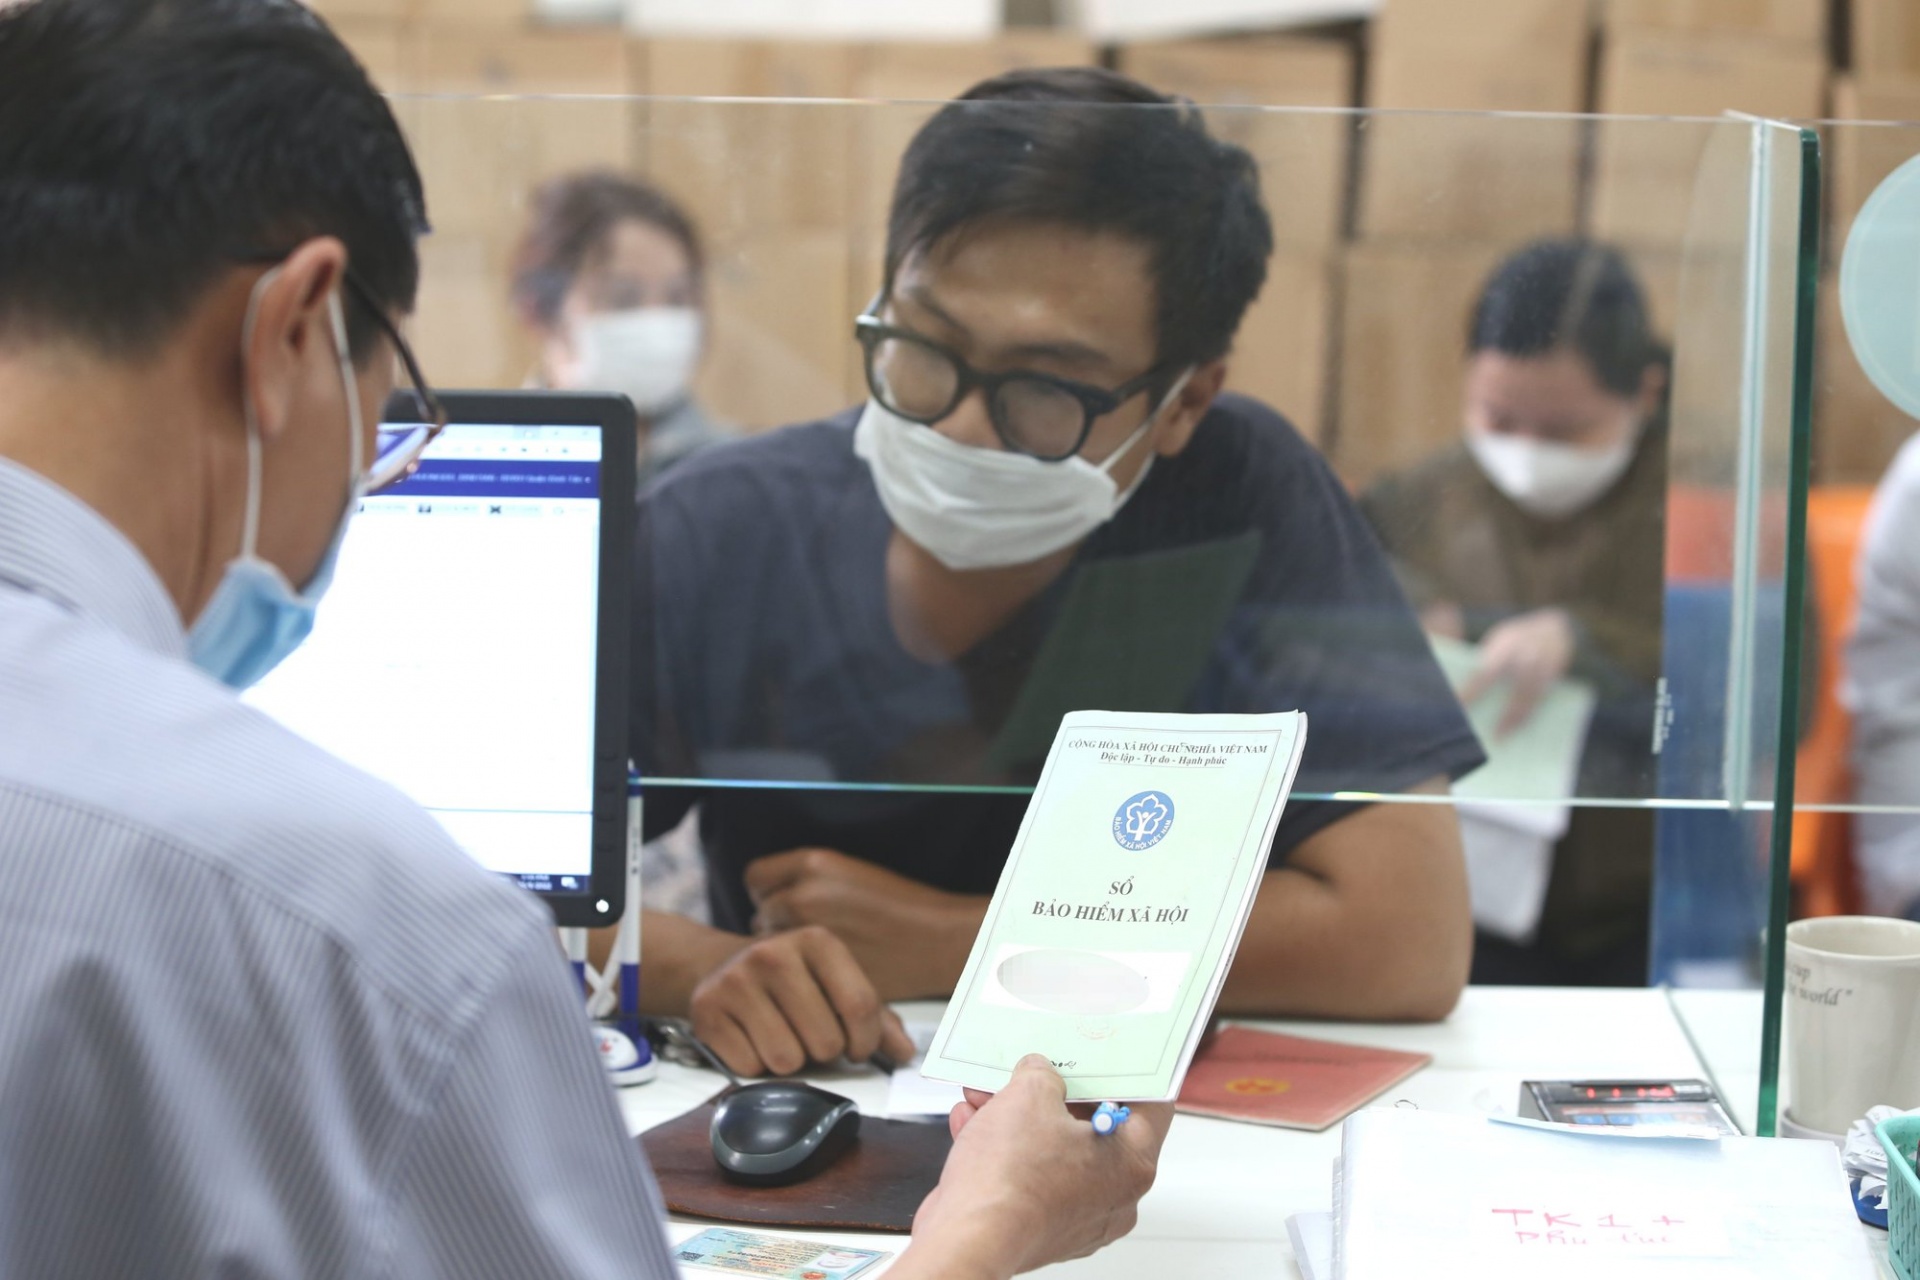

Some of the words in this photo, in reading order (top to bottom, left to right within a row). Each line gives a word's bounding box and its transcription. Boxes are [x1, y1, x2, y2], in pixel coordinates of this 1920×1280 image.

[1068, 738, 1097, 749] CỘNG
[1098, 739, 1120, 750] HÒA
[1122, 741, 1137, 751] XÃ
[1138, 741, 1159, 753] HỘI
[1219, 743, 1244, 755] VIỆT
[1244, 744, 1268, 754] NAM
[1100, 751, 1119, 763] Độc
[1120, 752, 1135, 764] lập
[1143, 754, 1157, 765] Tự
[1158, 755, 1170, 764] do
[1178, 756, 1203, 766] Hạnh
[1204, 756, 1227, 767] phúc
[1108, 875, 1135, 896] SỔ
[1032, 898, 1072, 918] BẢO
[1074, 901, 1125, 922] HIỂM
[1127, 905, 1152, 923] XÃ
[1155, 905, 1190, 925] HỘI
